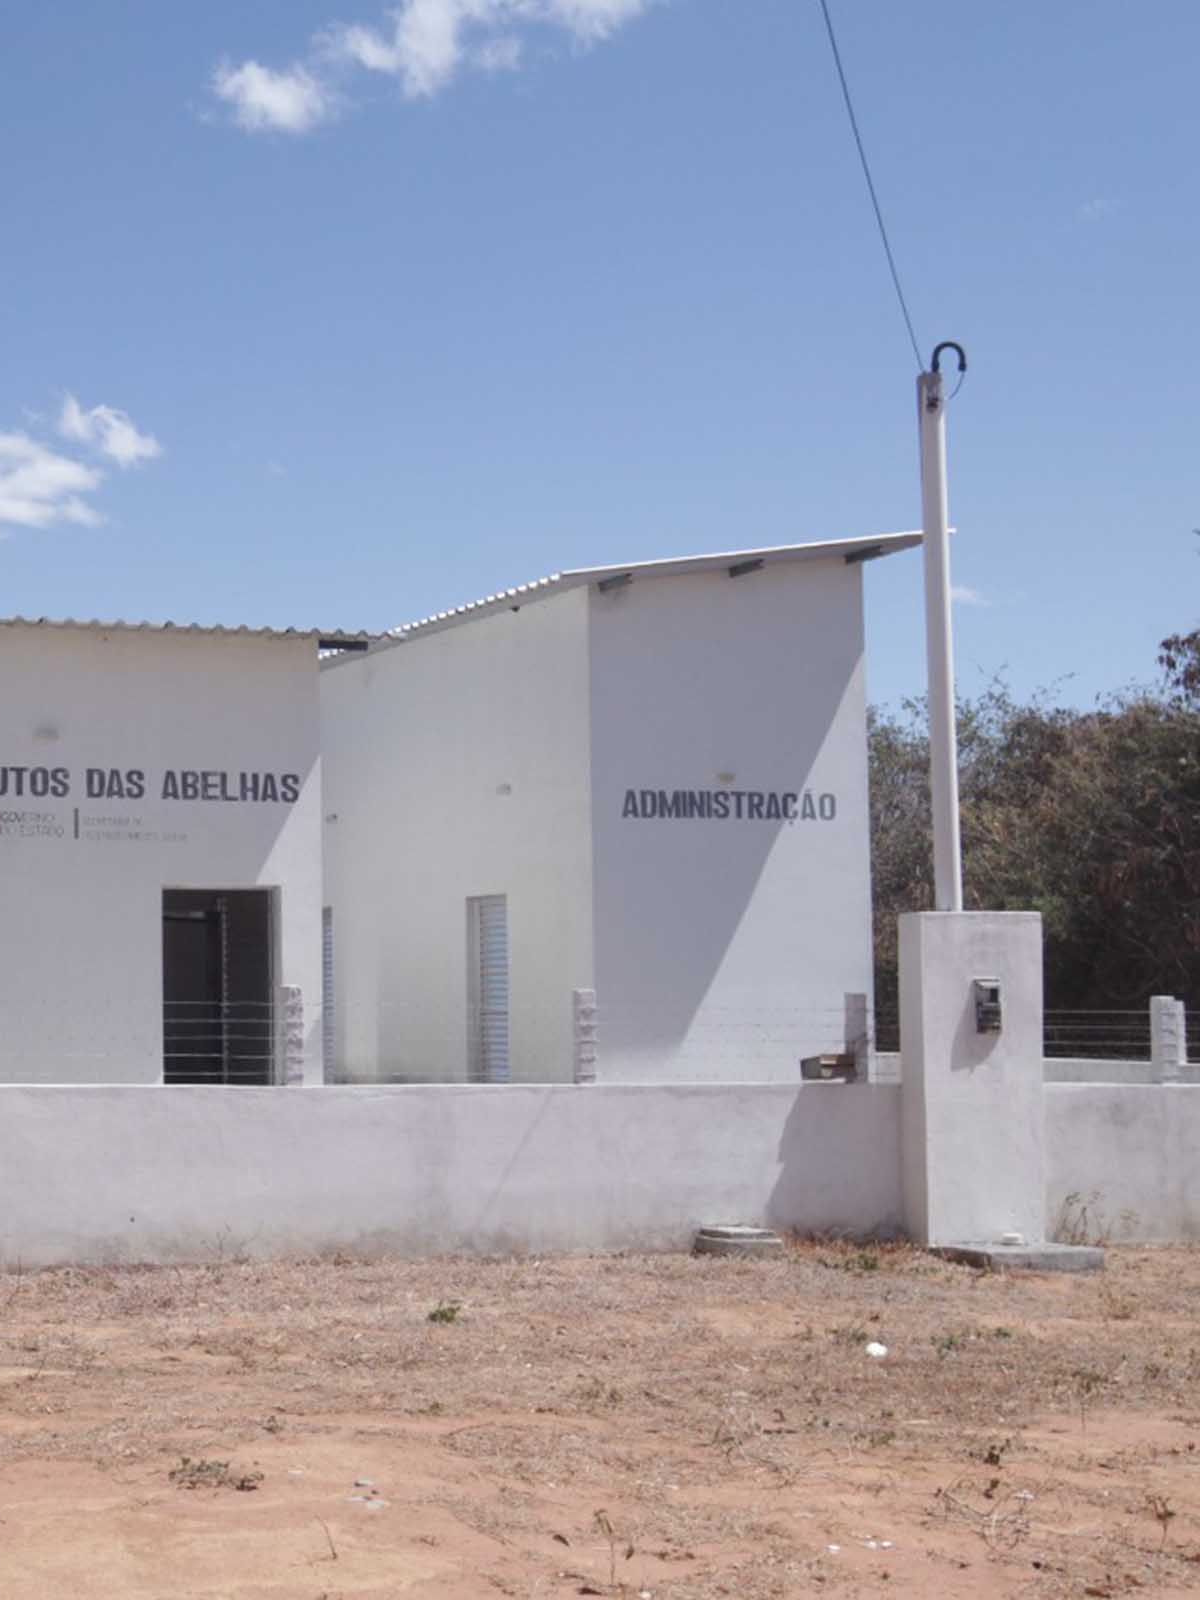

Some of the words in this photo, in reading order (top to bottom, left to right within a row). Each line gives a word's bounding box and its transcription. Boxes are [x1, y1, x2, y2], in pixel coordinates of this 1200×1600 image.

[86, 768, 144, 799] DAS
[161, 770, 299, 803] ABELHAS
[622, 789, 836, 824] ADMINISTRAÇÃO
